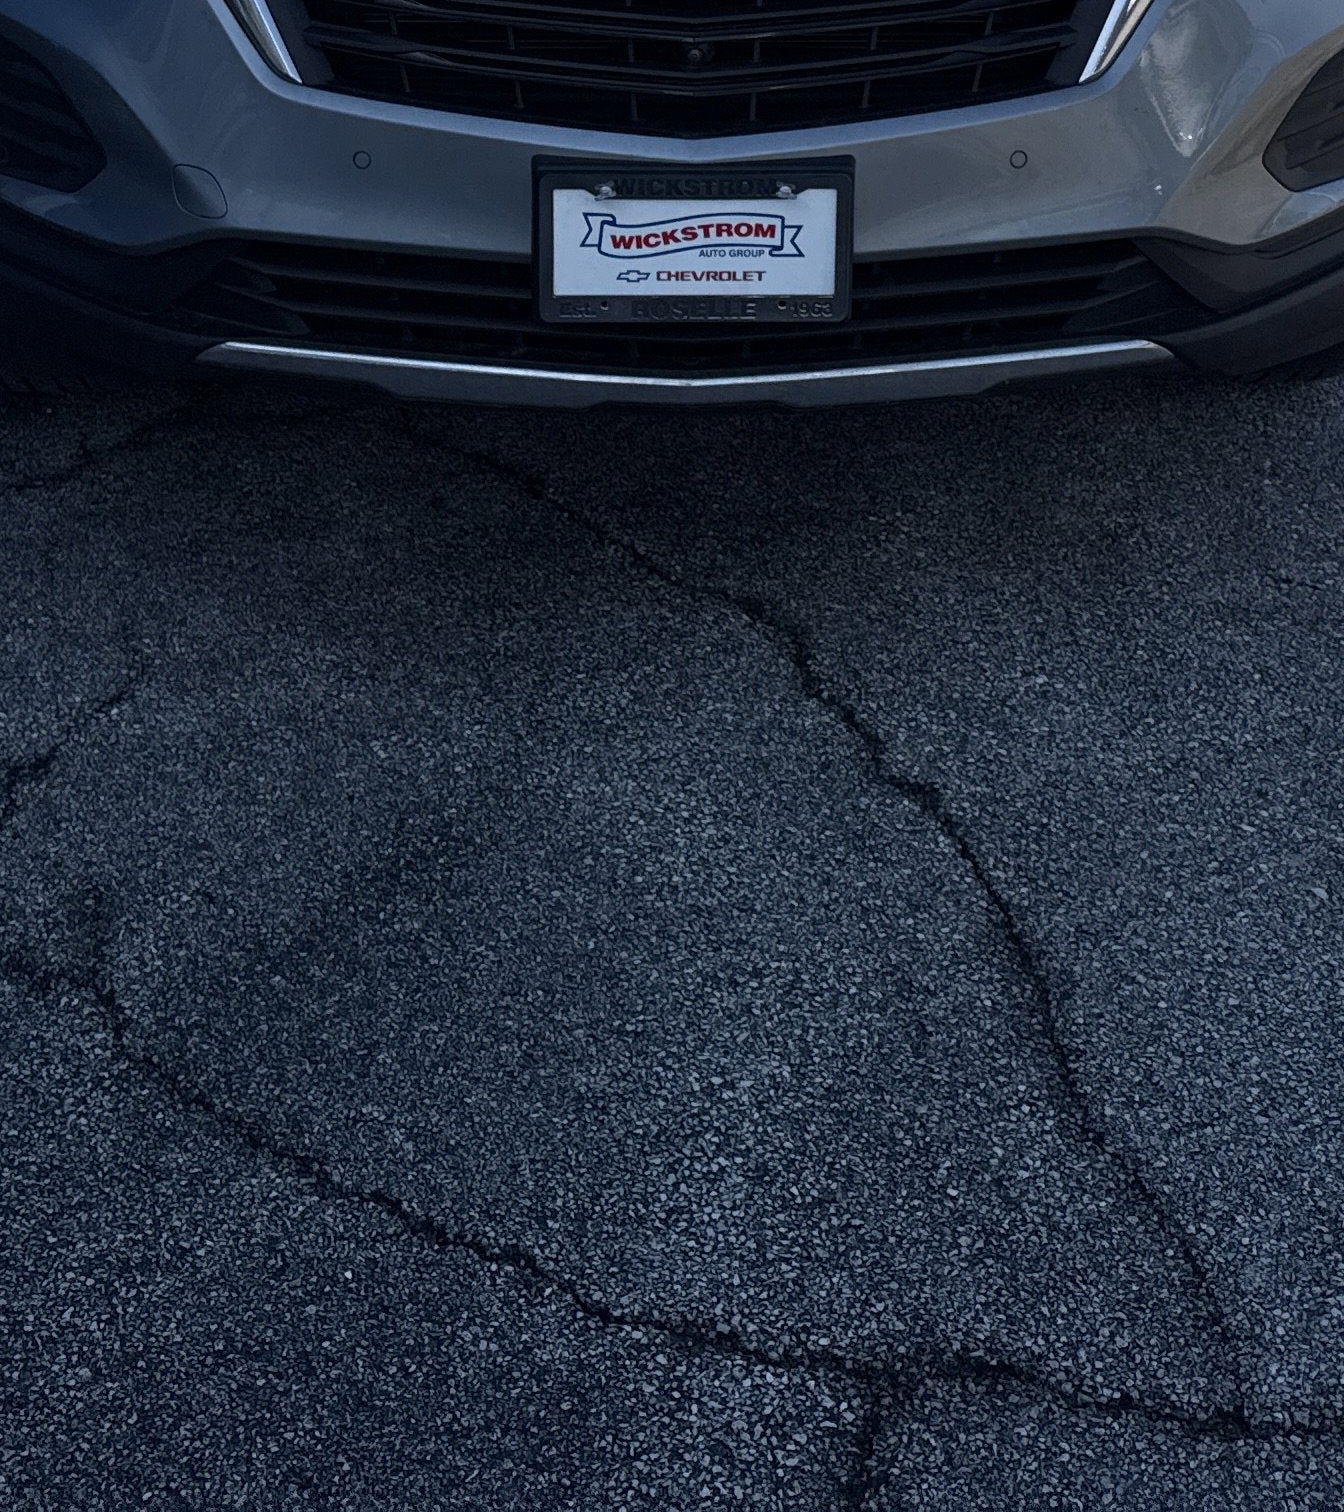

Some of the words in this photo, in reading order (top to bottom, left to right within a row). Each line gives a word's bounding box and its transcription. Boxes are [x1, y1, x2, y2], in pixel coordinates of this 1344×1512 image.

[615, 178, 777, 196] WICKSTROM
[610, 223, 776, 250] WICKSTROM
[698, 249, 726, 257] AUTO
[729, 249, 765, 257] GROUP
[656, 271, 766, 282] CHEVROLET
